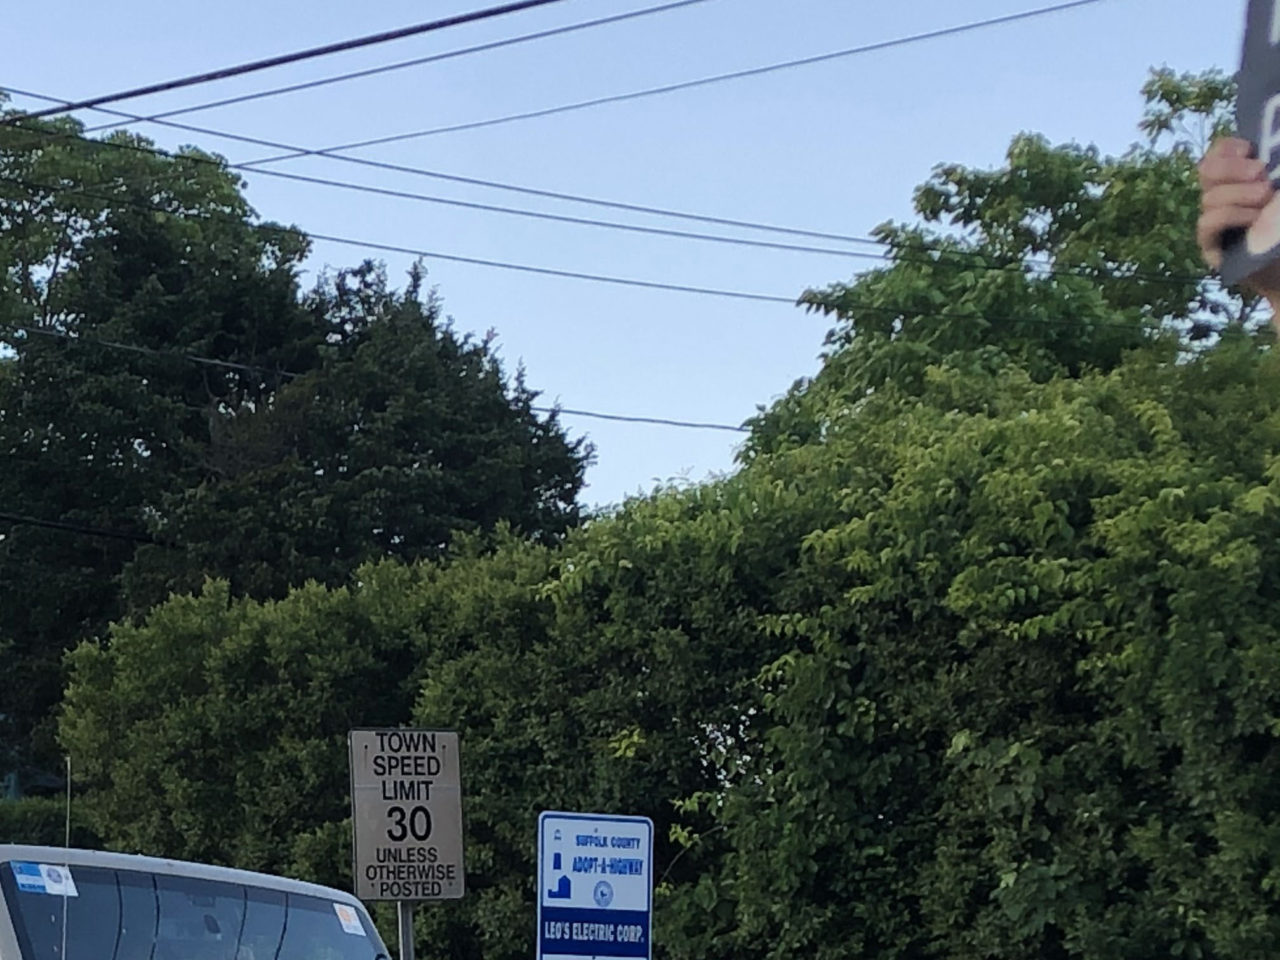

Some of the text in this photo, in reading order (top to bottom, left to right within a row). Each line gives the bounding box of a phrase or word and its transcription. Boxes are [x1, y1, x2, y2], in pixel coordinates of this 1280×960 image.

[375, 732, 436, 753] TOWN
[373, 755, 441, 777] SPEED
[381, 780, 434, 801] LIMIT
[387, 805, 432, 842] 30
[576, 834, 641, 849] SUFFOLK COUNTY
[376, 847, 438, 863] UNLESS
[365, 864, 456, 881] OTHERWISE
[572, 856, 644, 876] ADOPT-A-HIGHWAY
[380, 881, 442, 897] POSTED
[545, 921, 645, 943] LEO'S ELECTRIC CORP.
